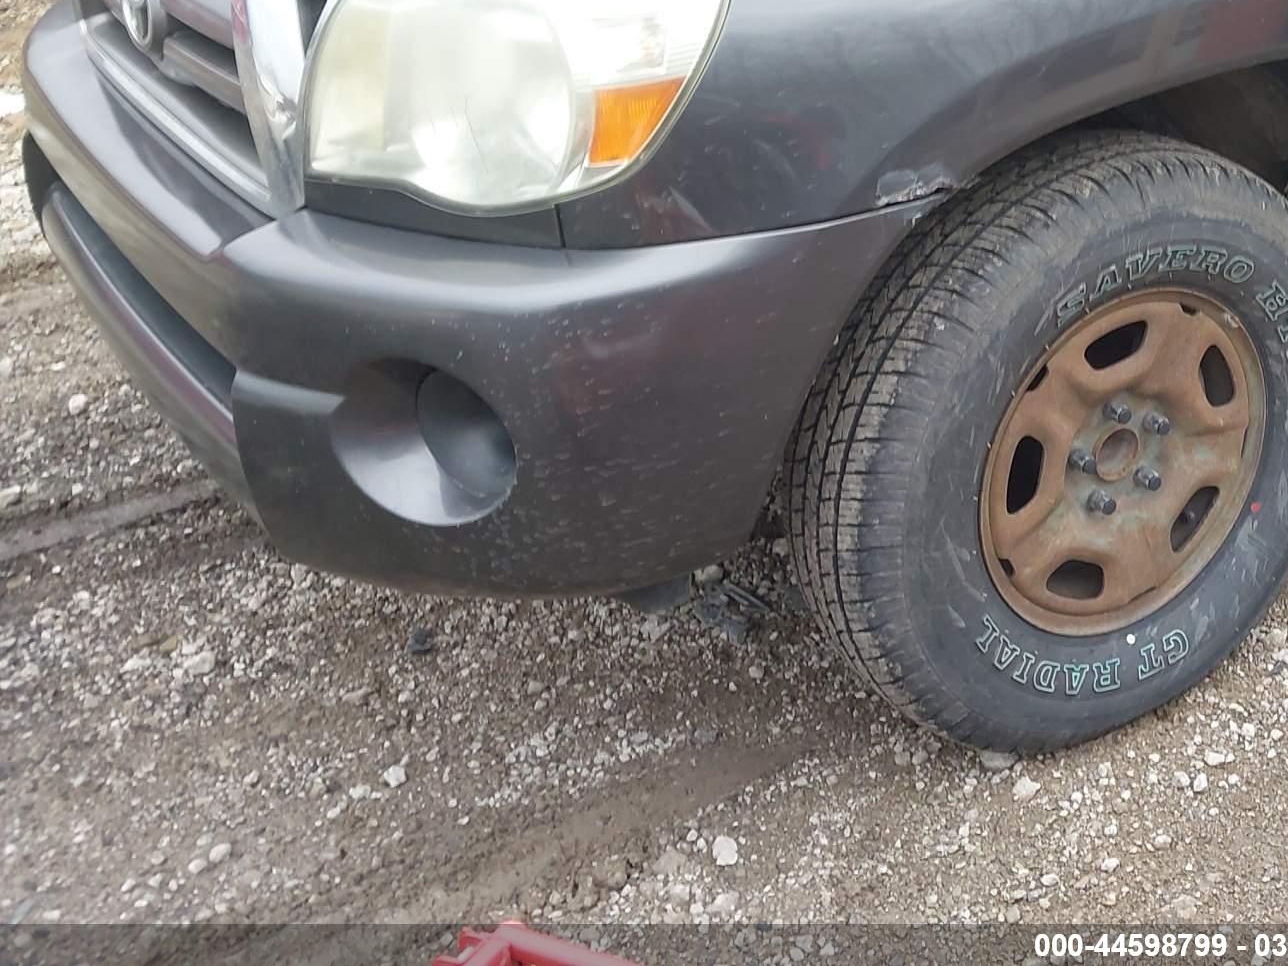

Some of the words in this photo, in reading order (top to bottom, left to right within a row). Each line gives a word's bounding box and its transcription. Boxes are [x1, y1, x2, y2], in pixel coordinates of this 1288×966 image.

[1055, 243, 1255, 329] SAVERO
[975, 614, 1121, 695] RADIAL
[1137, 628, 1190, 681] GT
